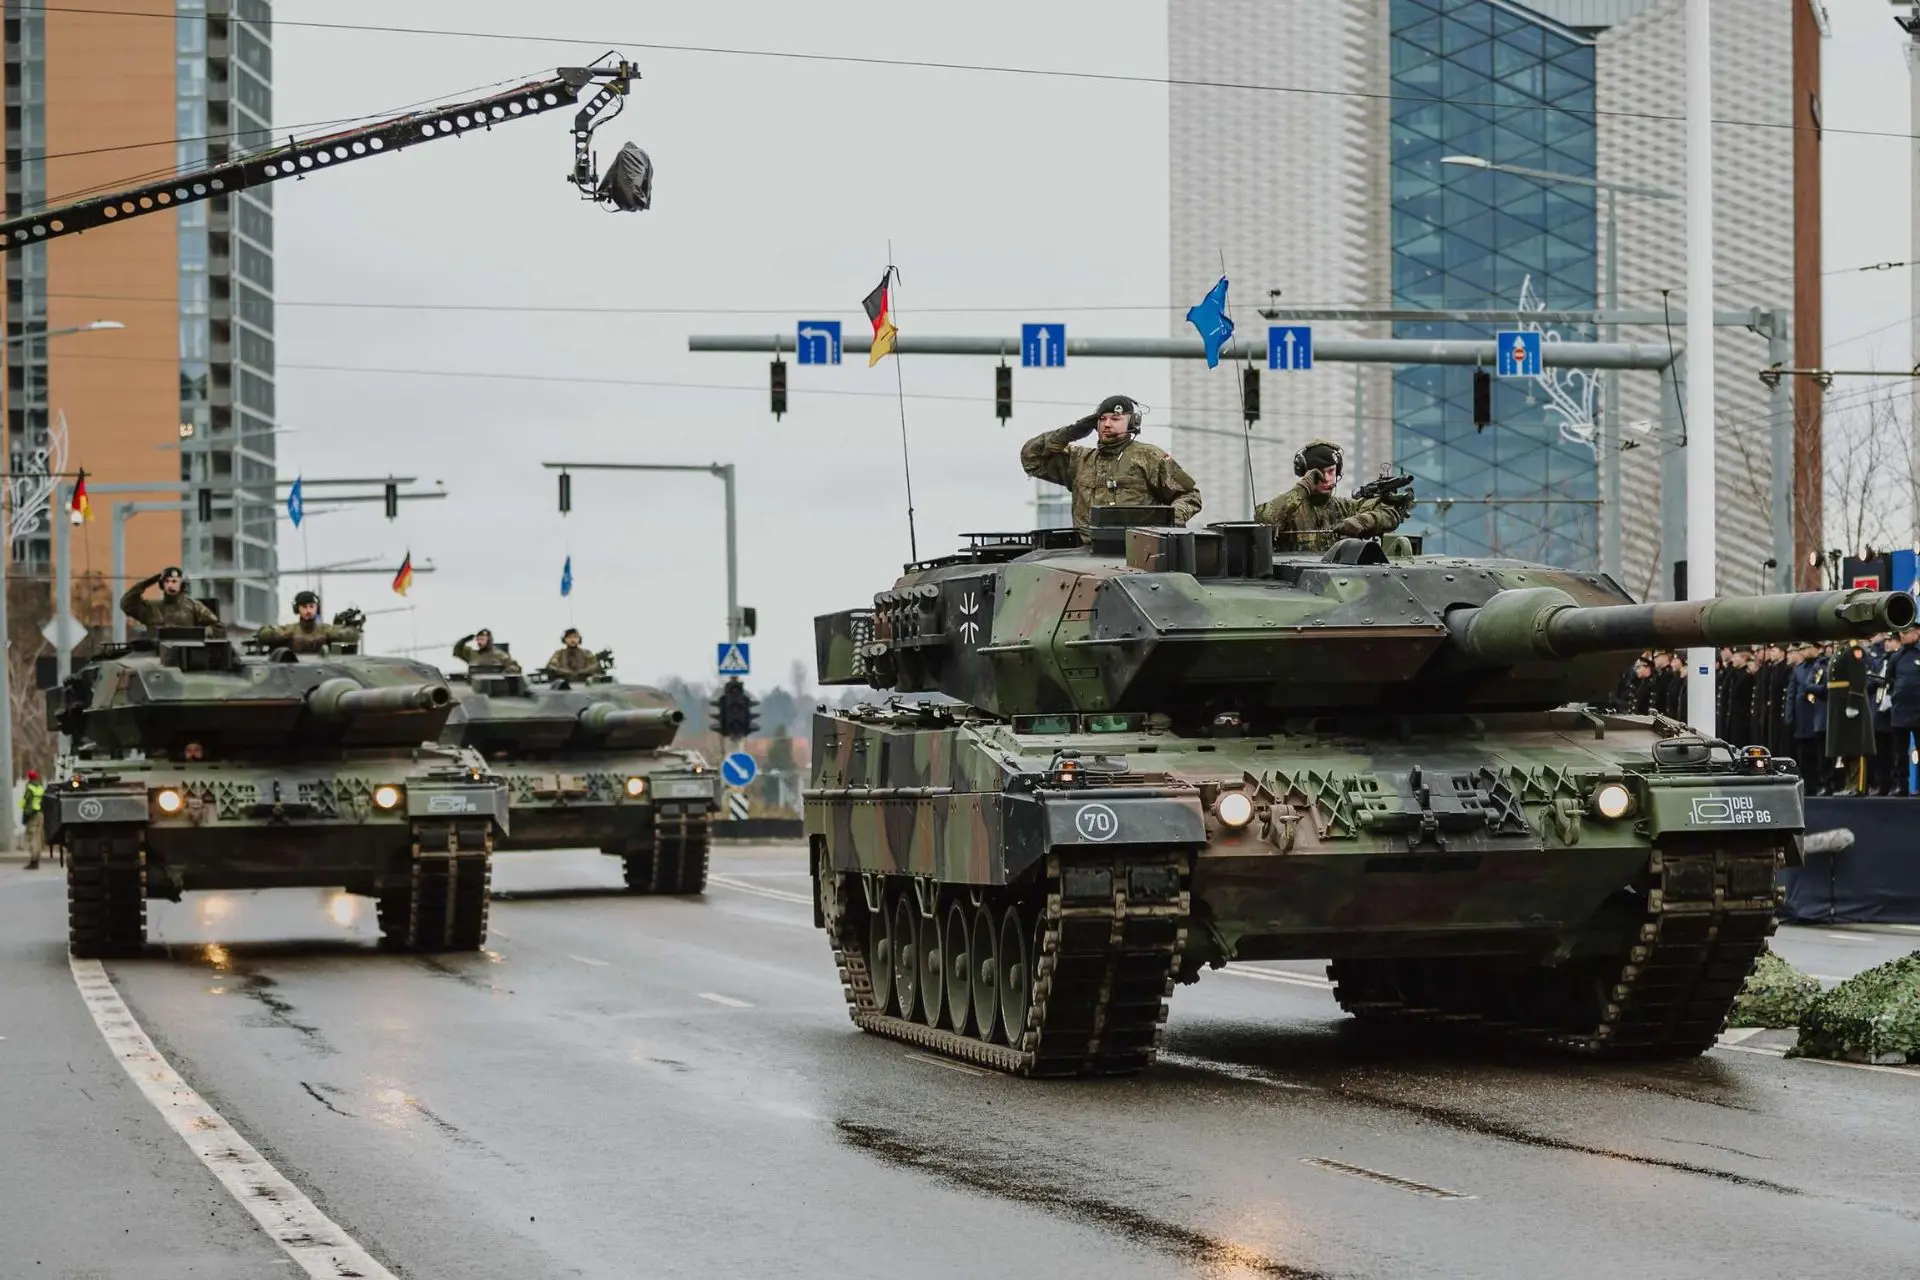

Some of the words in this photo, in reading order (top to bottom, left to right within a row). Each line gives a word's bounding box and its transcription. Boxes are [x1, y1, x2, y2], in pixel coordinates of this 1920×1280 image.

[83, 804, 98, 815] 70
[1733, 796, 1753, 810] DEU
[1084, 813, 1110, 832] 70
[1735, 810, 1754, 824] eFP
[1756, 810, 1771, 823] BG
